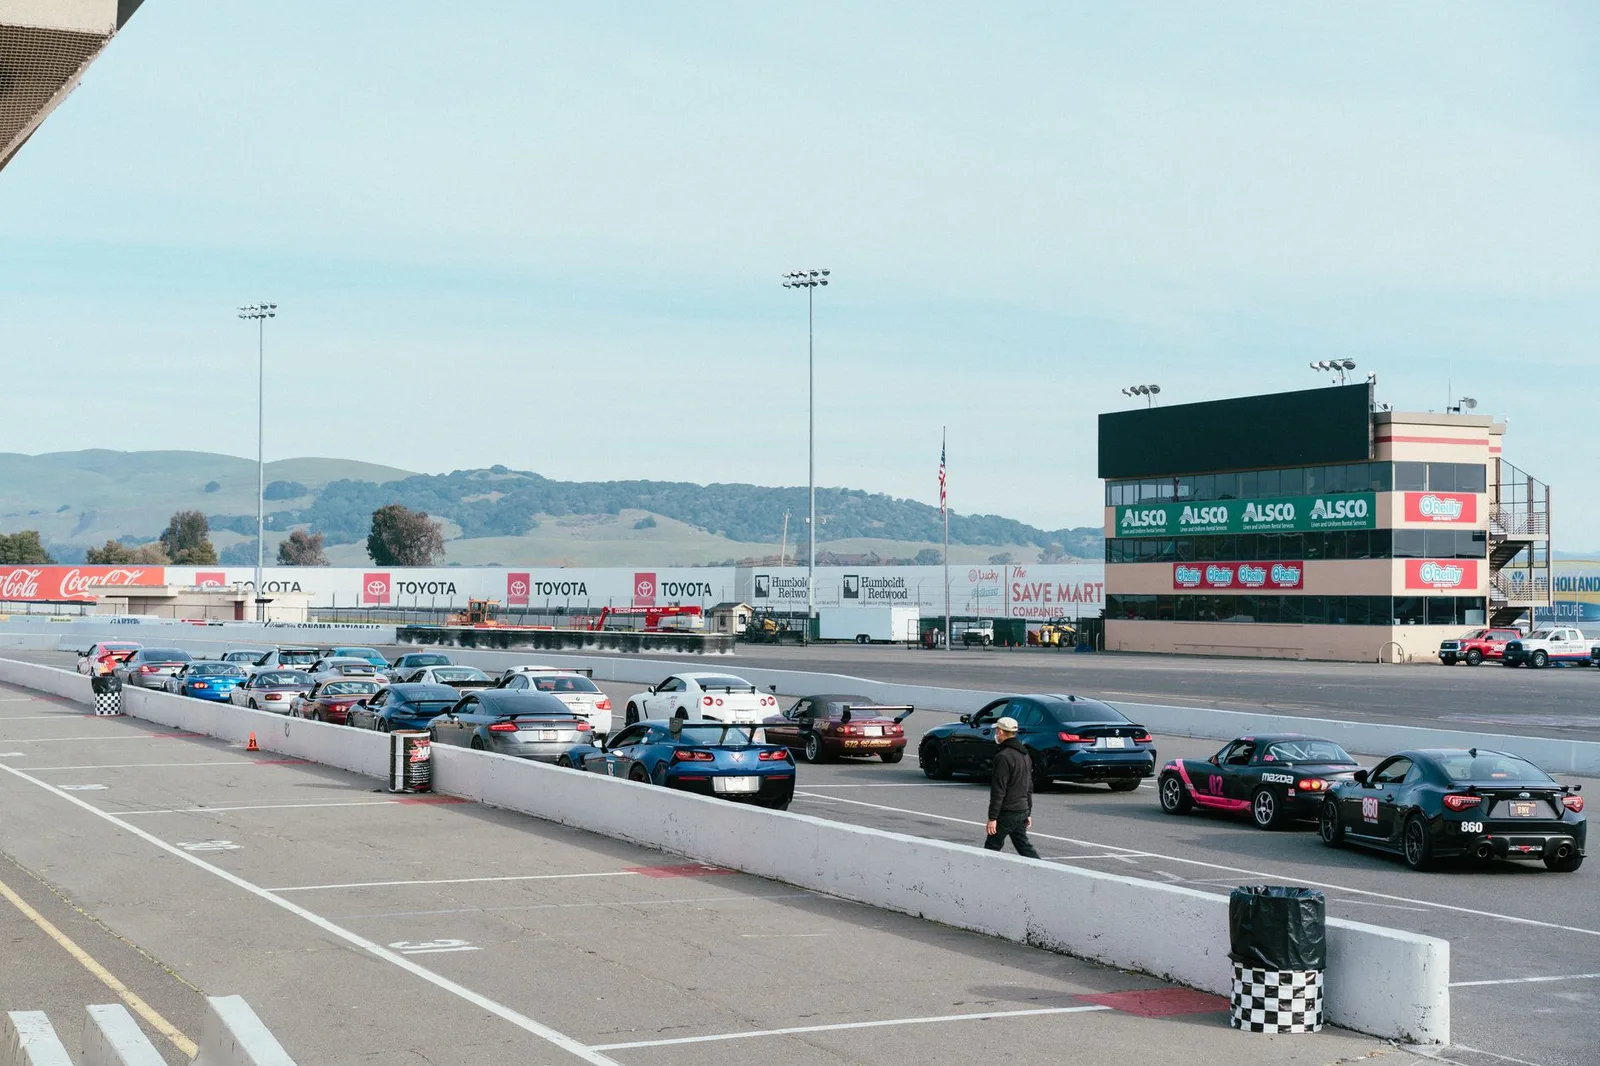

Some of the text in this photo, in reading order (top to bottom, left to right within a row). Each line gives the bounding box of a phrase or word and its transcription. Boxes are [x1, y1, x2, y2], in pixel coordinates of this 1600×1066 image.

[1180, 506, 1228, 524] ALSCO
[1241, 502, 1294, 522] ALSCO
[1309, 499, 1368, 520] ALSCO
[1121, 508, 1166, 528] ALSCO
[978, 569, 998, 582] Lucky
[1012, 566, 1026, 578] The
[396, 581, 457, 594] TOYOTA
[772, 576, 808, 588] Humbol
[861, 576, 905, 588] Humboldt
[535, 582, 588, 596] TOYOTA
[661, 582, 712, 596] TOYOTA
[778, 588, 807, 598] Redwo
[868, 588, 908, 599] Redwood
[1012, 582, 1052, 602] SAVE
[1057, 582, 1104, 602] MART
[1012, 606, 1064, 617] COMPANIES
[249, 739, 256, 747] 21
[1209, 775, 1224, 795] 02
[1362, 797, 1378, 818] 860
[1461, 821, 1483, 833] 860
